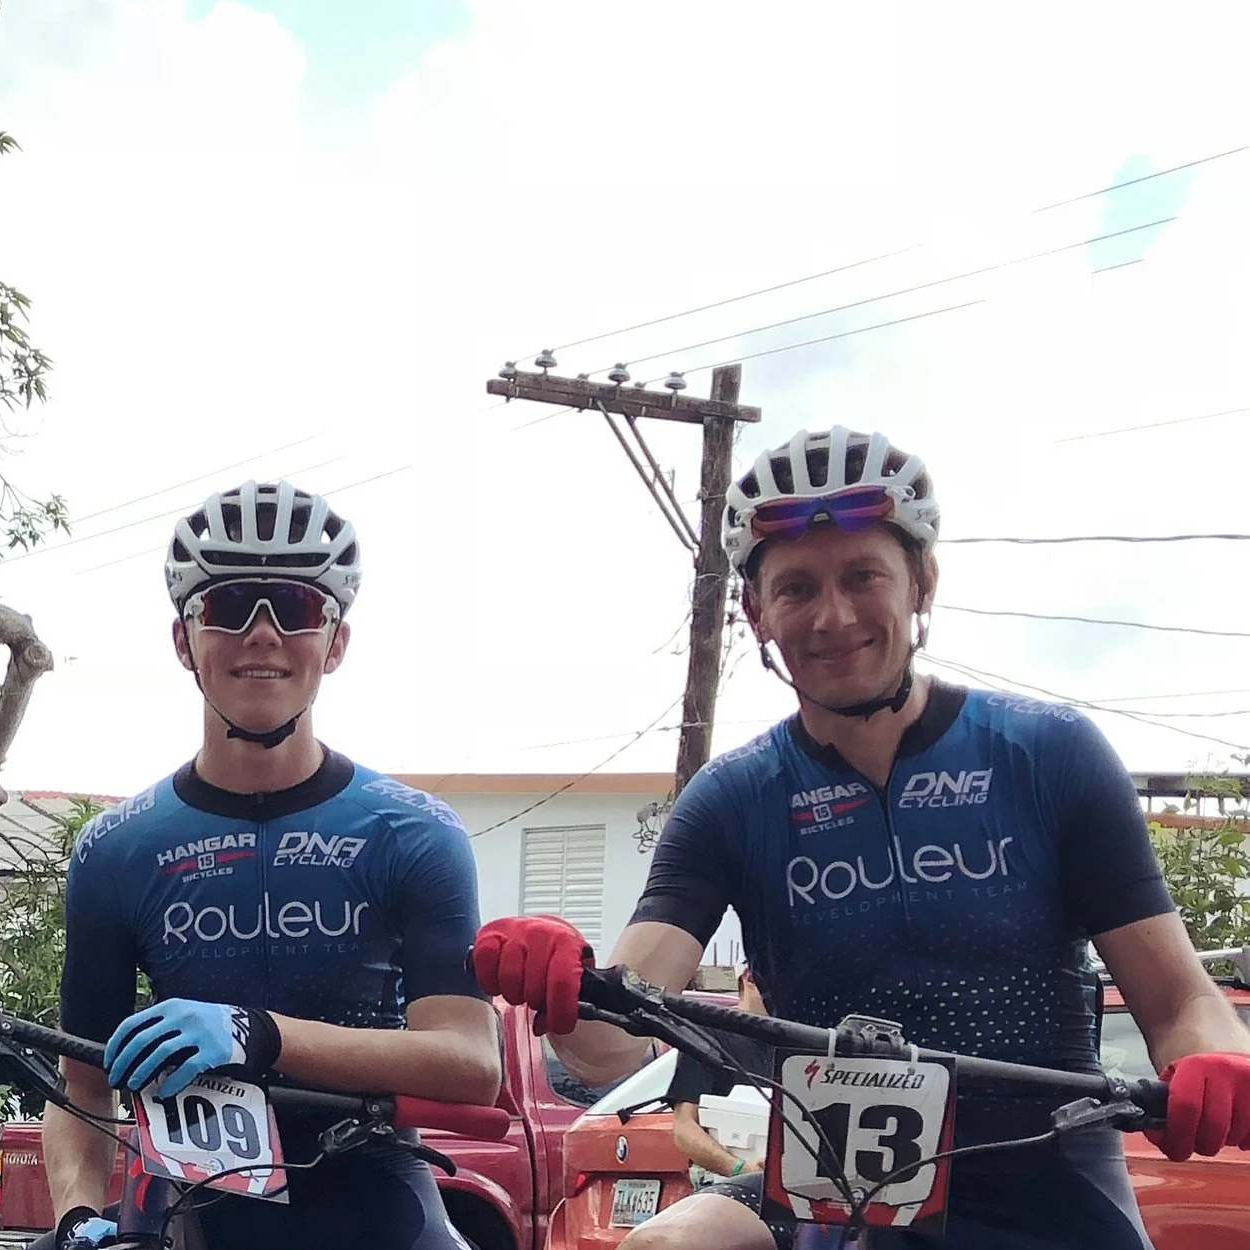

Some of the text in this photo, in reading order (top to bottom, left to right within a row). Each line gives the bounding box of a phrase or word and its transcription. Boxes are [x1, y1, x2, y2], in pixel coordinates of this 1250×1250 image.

[902, 767, 993, 797] DNA
[791, 782, 868, 808] ANGAR
[899, 793, 988, 808] CYCLING
[814, 805, 830, 821] 15
[800, 817, 855, 835] BICYCLES
[157, 833, 256, 866] HANGAR
[277, 832, 367, 857] DNA
[199, 854, 213, 869] 15
[273, 853, 355, 868] CYCLING
[787, 835, 1012, 906] Rouleur
[182, 867, 233, 882] BICYCLES
[973, 881, 1028, 897] TEAM
[163, 891, 369, 945] Rouleur
[193, 1077, 246, 1098] IALIZED
[820, 1068, 925, 1089] SPECIALIZED
[152, 1095, 261, 1160] 109
[802, 1102, 924, 1184] 13
[4, 1153, 38, 1165] TOYOTA
